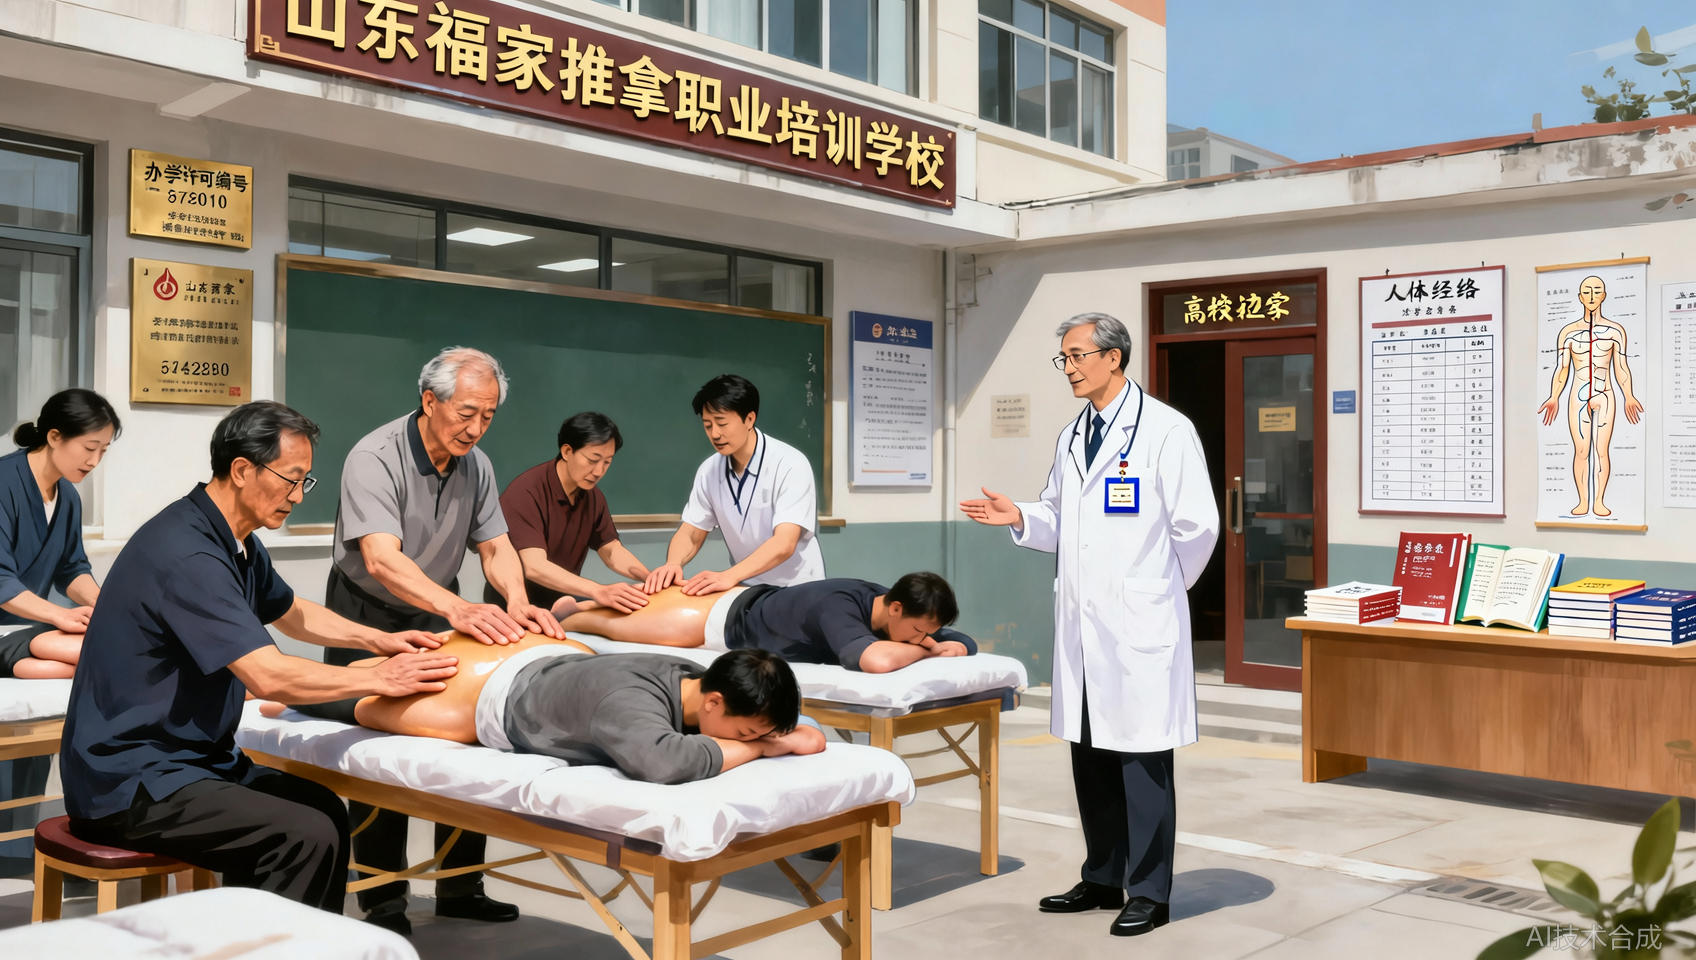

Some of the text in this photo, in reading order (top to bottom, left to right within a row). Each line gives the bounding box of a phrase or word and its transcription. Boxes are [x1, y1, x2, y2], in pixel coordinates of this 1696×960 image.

[286, 0, 945, 190] 山东福家推拿职业培训学校
[144, 161, 249, 193] 办学许可编号
[1384, 277, 1480, 303] 人体经络
